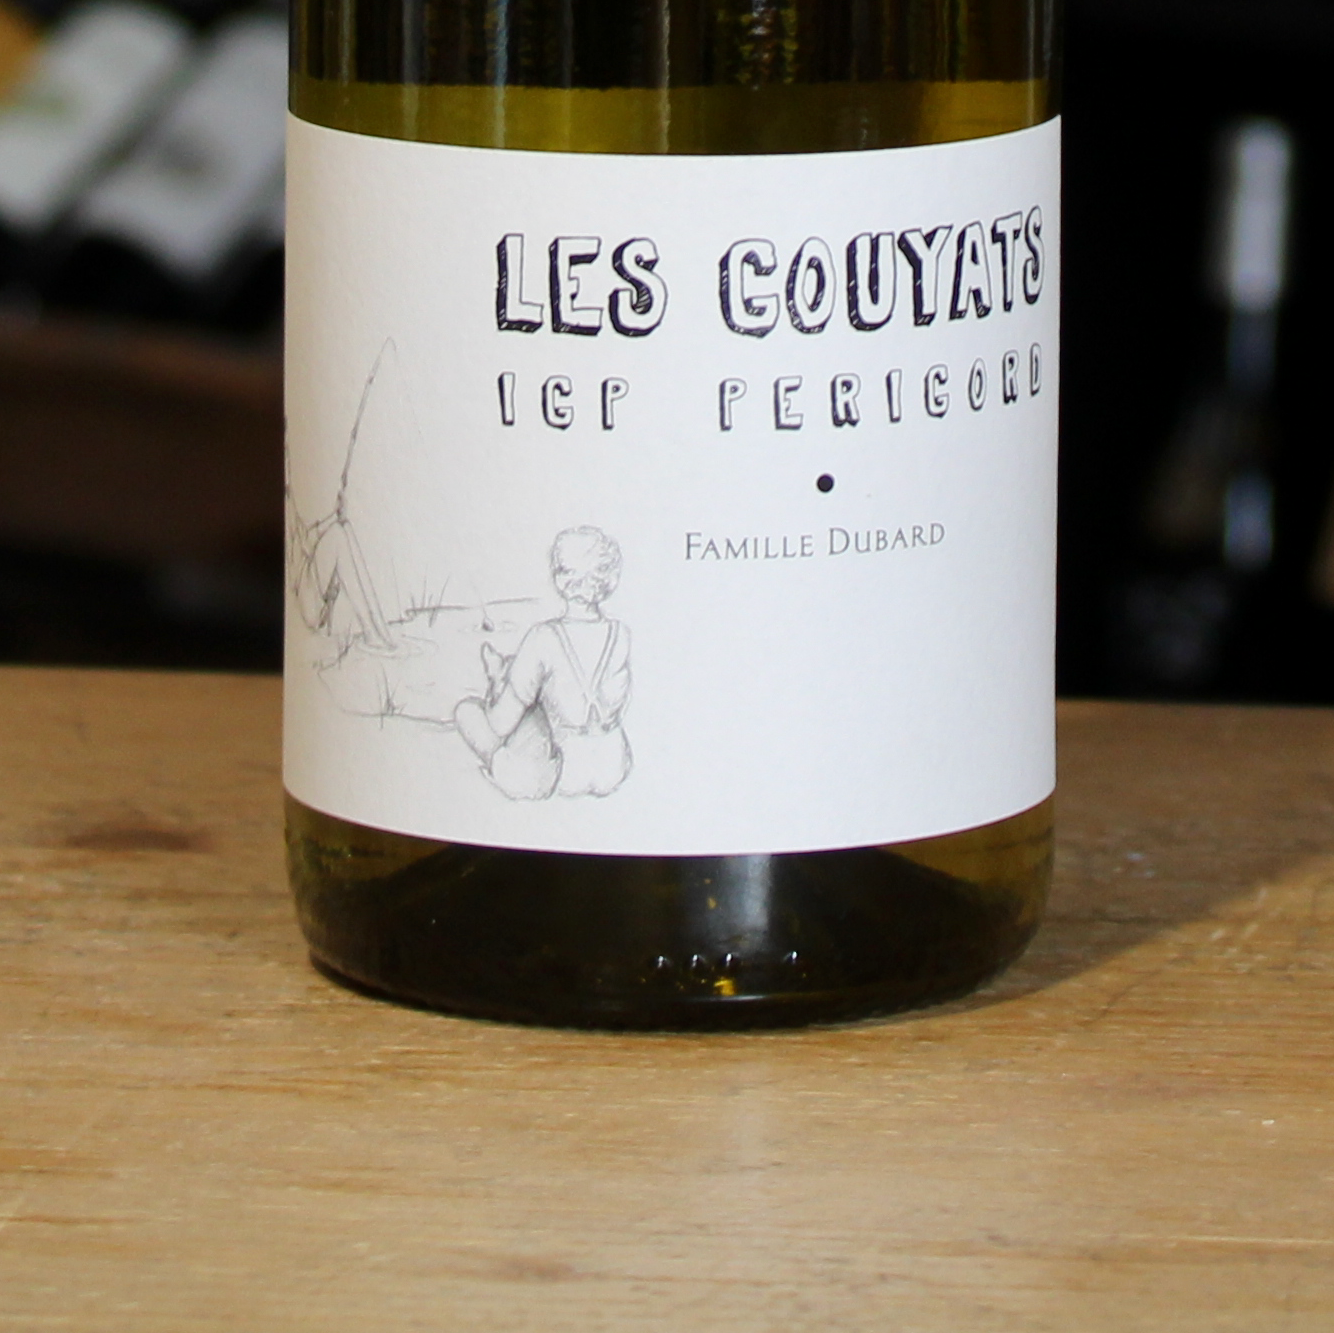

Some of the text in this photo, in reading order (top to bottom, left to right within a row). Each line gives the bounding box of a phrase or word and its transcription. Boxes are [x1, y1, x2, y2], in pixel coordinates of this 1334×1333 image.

[495, 206, 1042, 338] LES GOUYATS
[497, 342, 1042, 431] IGP PERIGORD
[685, 522, 945, 560] FAMILLE DUBARD
